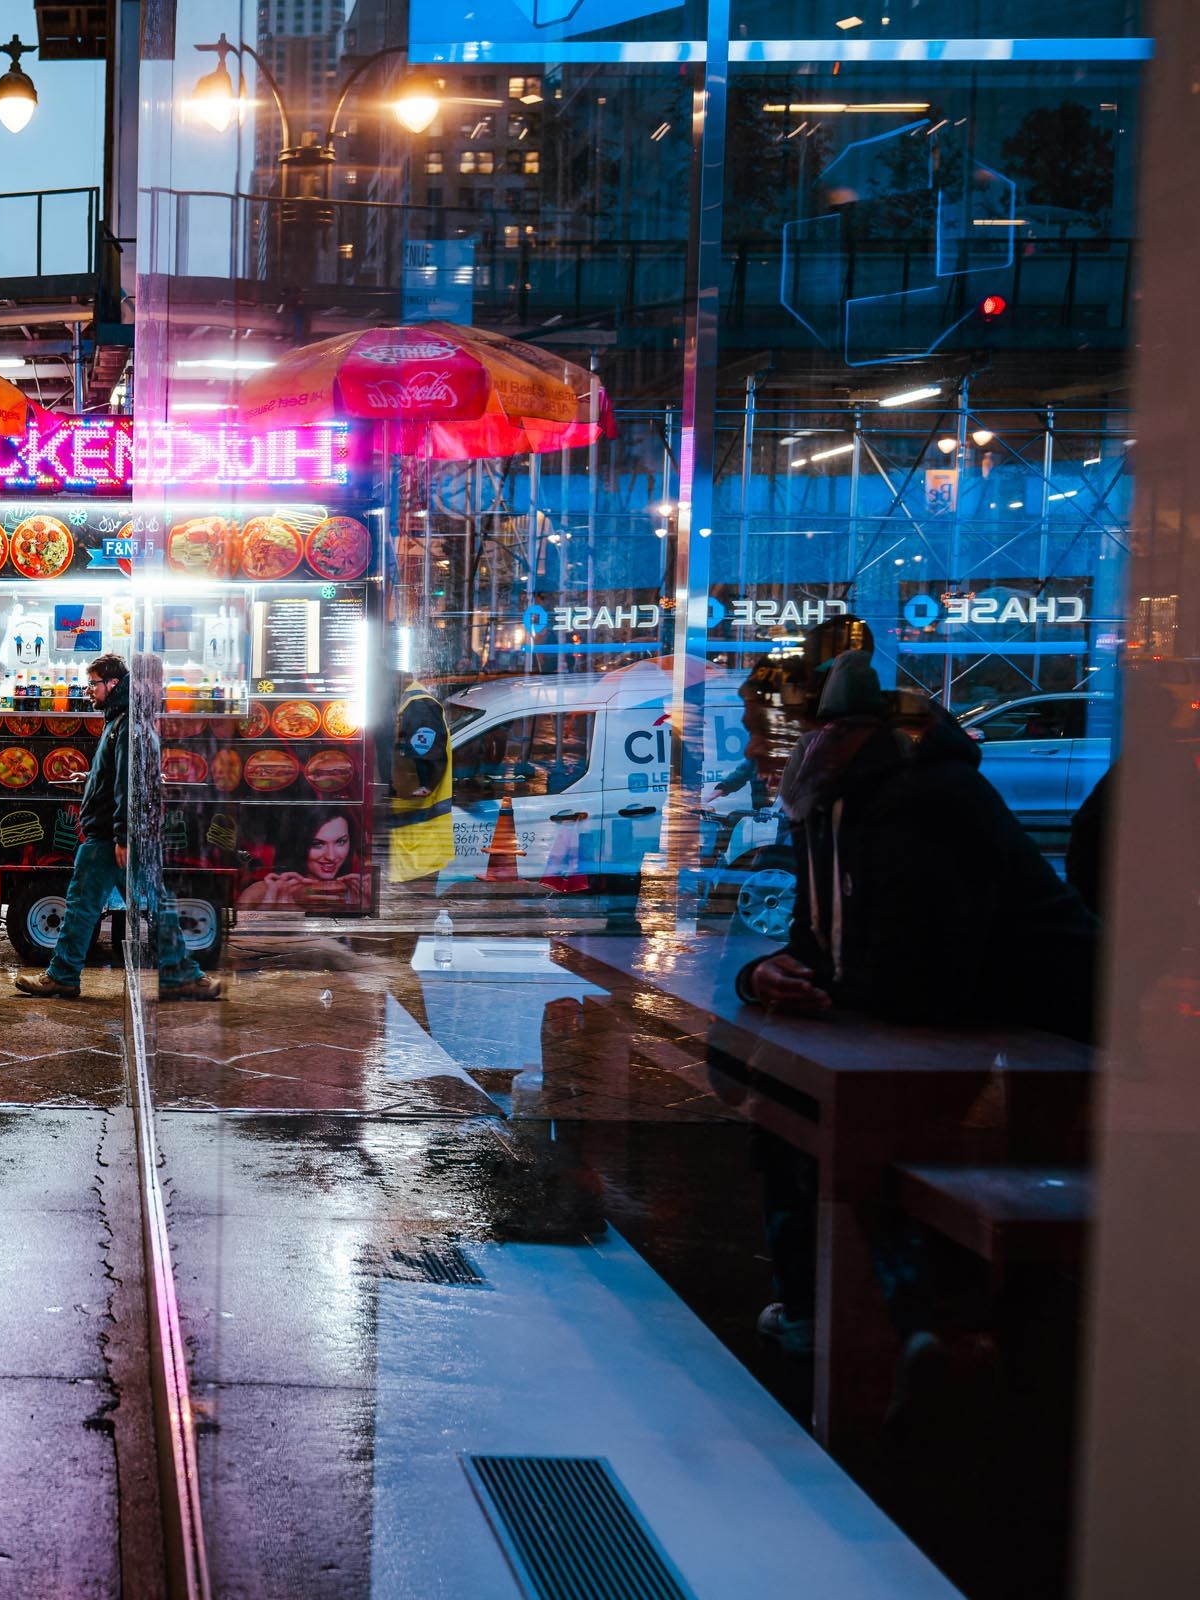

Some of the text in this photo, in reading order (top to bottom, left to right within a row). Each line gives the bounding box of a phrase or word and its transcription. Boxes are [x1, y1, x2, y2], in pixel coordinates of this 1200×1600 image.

[80, 619, 95, 627] Bull
[452, 822, 493, 834] BS, LLC
[454, 833, 480, 844] 36th
[455, 845, 480, 857] klyn,
